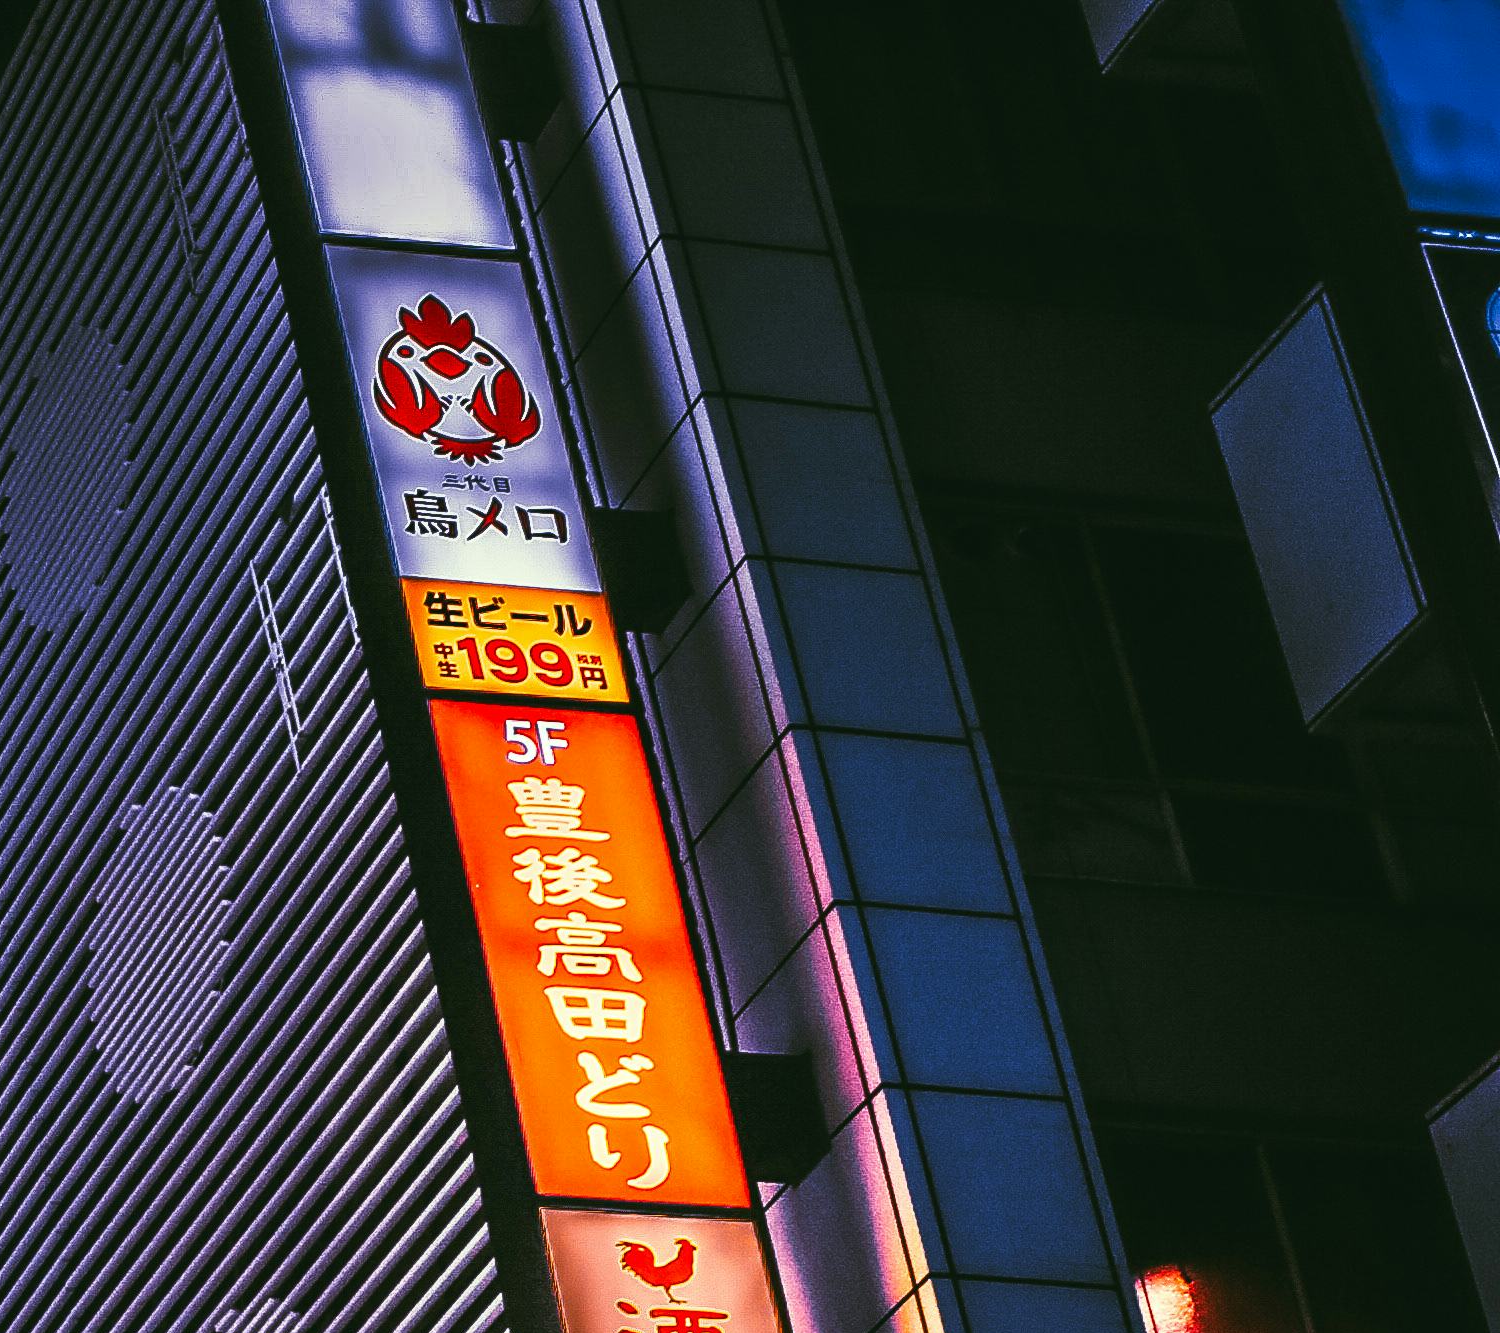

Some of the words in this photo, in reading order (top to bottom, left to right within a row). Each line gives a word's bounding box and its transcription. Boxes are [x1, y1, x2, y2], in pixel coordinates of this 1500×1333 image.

[442, 474, 513, 493] 三代目
[404, 490, 569, 545] 鳥メロ
[423, 591, 592, 637] 生ビール
[434, 642, 459, 679] 中生
[457, 638, 573, 688] 199
[580, 666, 607, 690] 円
[503, 718, 569, 765] 5F
[504, 776, 674, 1190] 豊後高田どり
